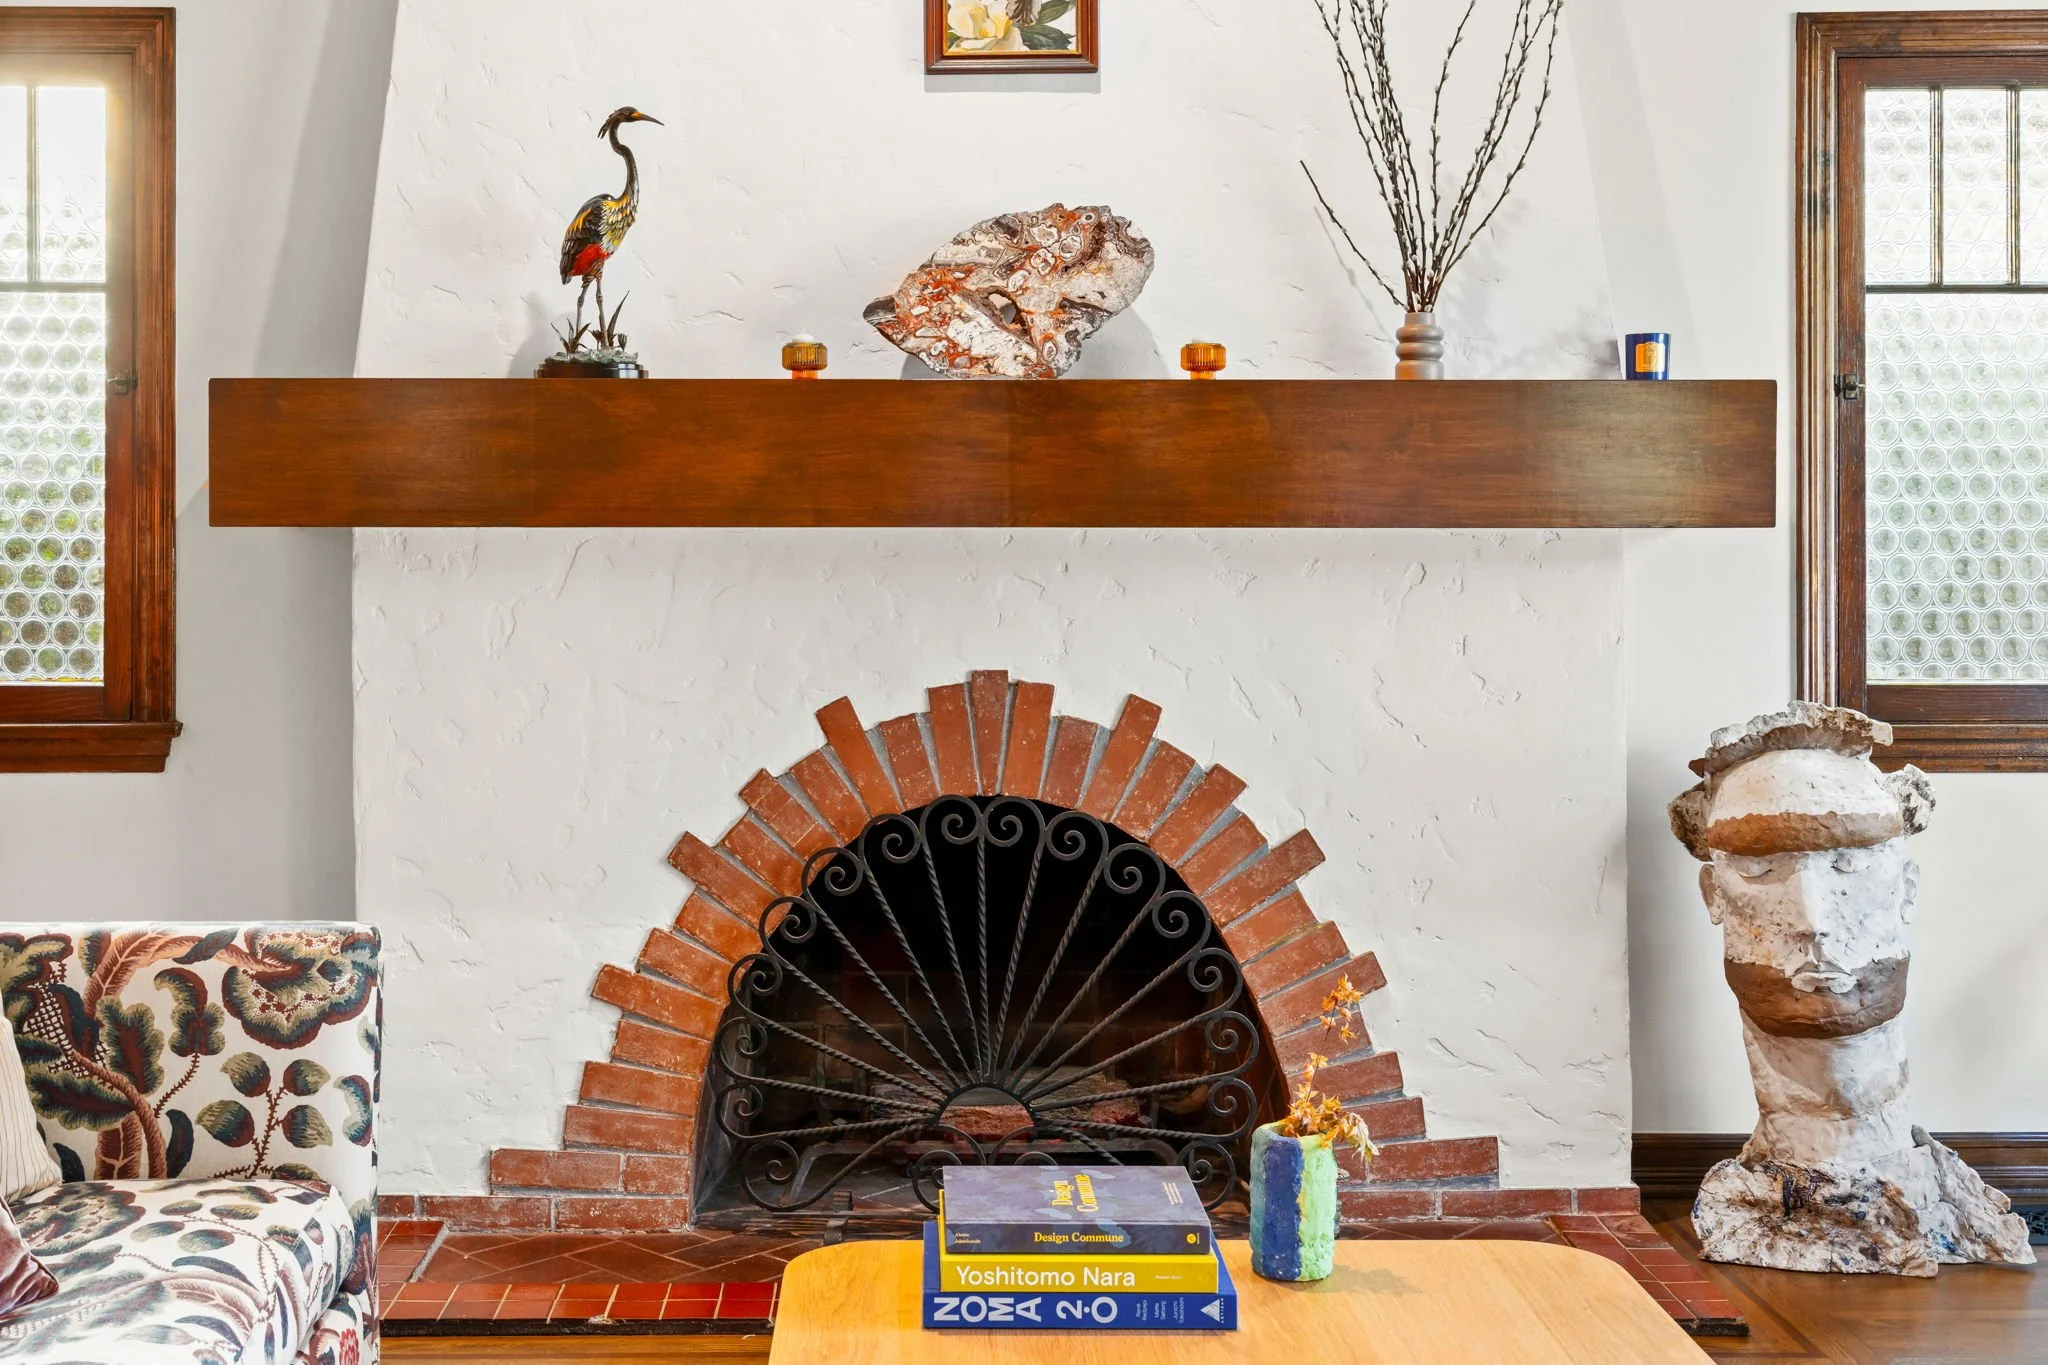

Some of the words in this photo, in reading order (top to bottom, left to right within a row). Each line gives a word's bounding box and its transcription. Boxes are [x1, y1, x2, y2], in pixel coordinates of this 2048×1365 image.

[1048, 1180, 1074, 1206] Design
[1074, 1174, 1098, 1212] Commune
[1034, 1232, 1069, 1245] Design
[1071, 1232, 1124, 1242] Commune
[956, 1265, 1075, 1286] Yoshitomo
[1083, 1267, 1136, 1287] Nara
[933, 1295, 1042, 1323] NOMA
